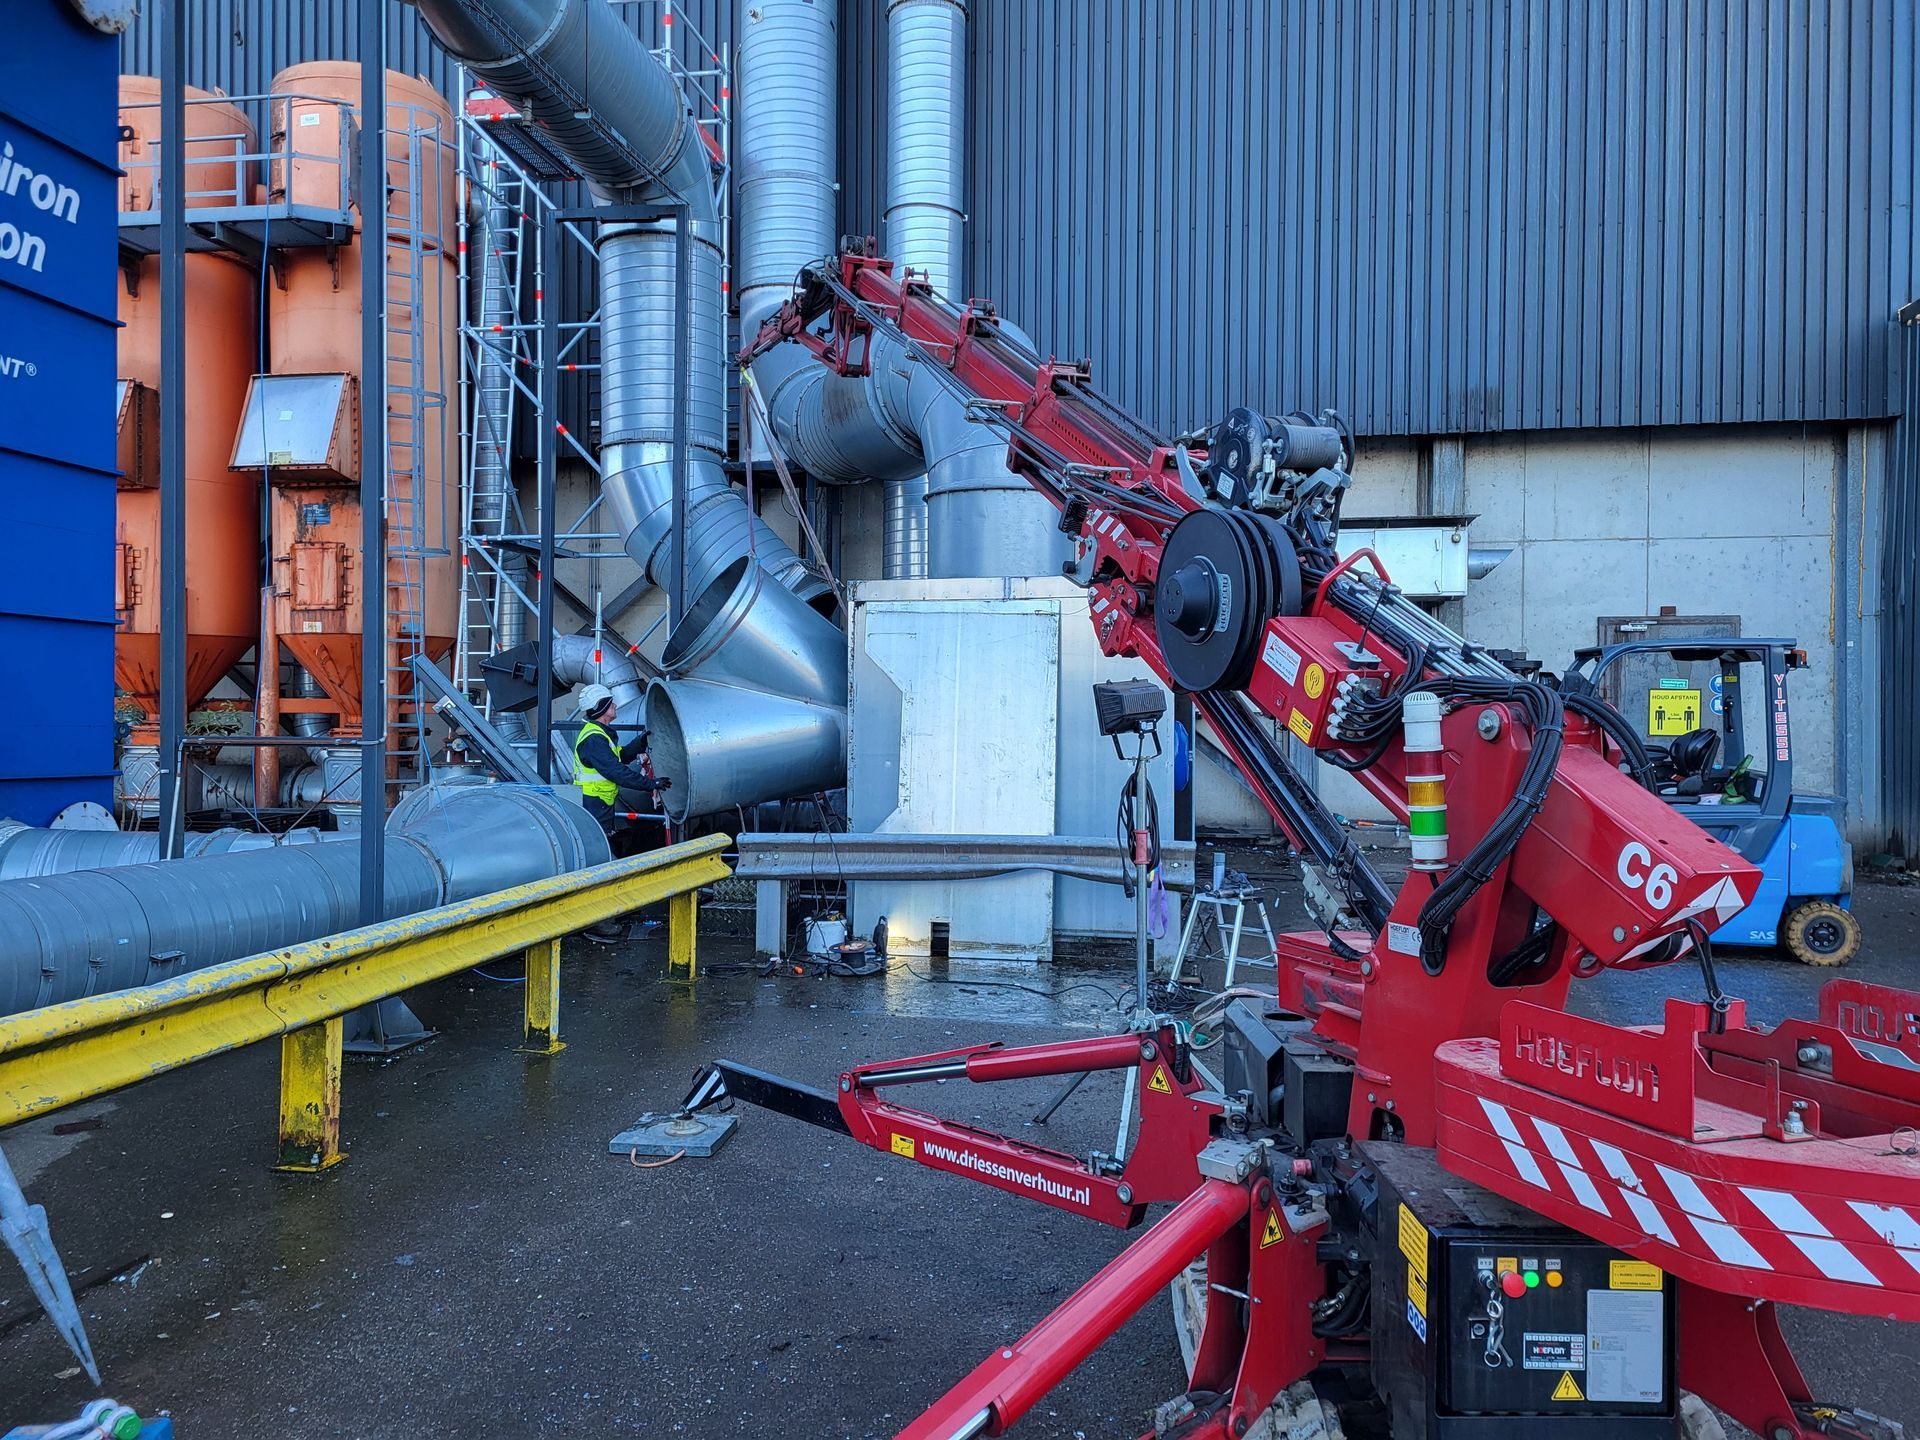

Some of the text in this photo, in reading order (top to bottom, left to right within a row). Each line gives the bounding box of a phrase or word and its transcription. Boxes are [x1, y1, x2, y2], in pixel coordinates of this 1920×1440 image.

[0, 141, 81, 224] iron
[0, 222, 46, 272] on
[1774, 674, 1789, 761] VITESSE
[1617, 842, 1678, 910] C6
[1750, 930, 1775, 940] SAS
[1516, 1025, 1660, 1102] HOEFLON
[924, 1141, 1090, 1206] www.driessenverhuur.nl
[1533, 1346, 1565, 1354] HOEFLON
